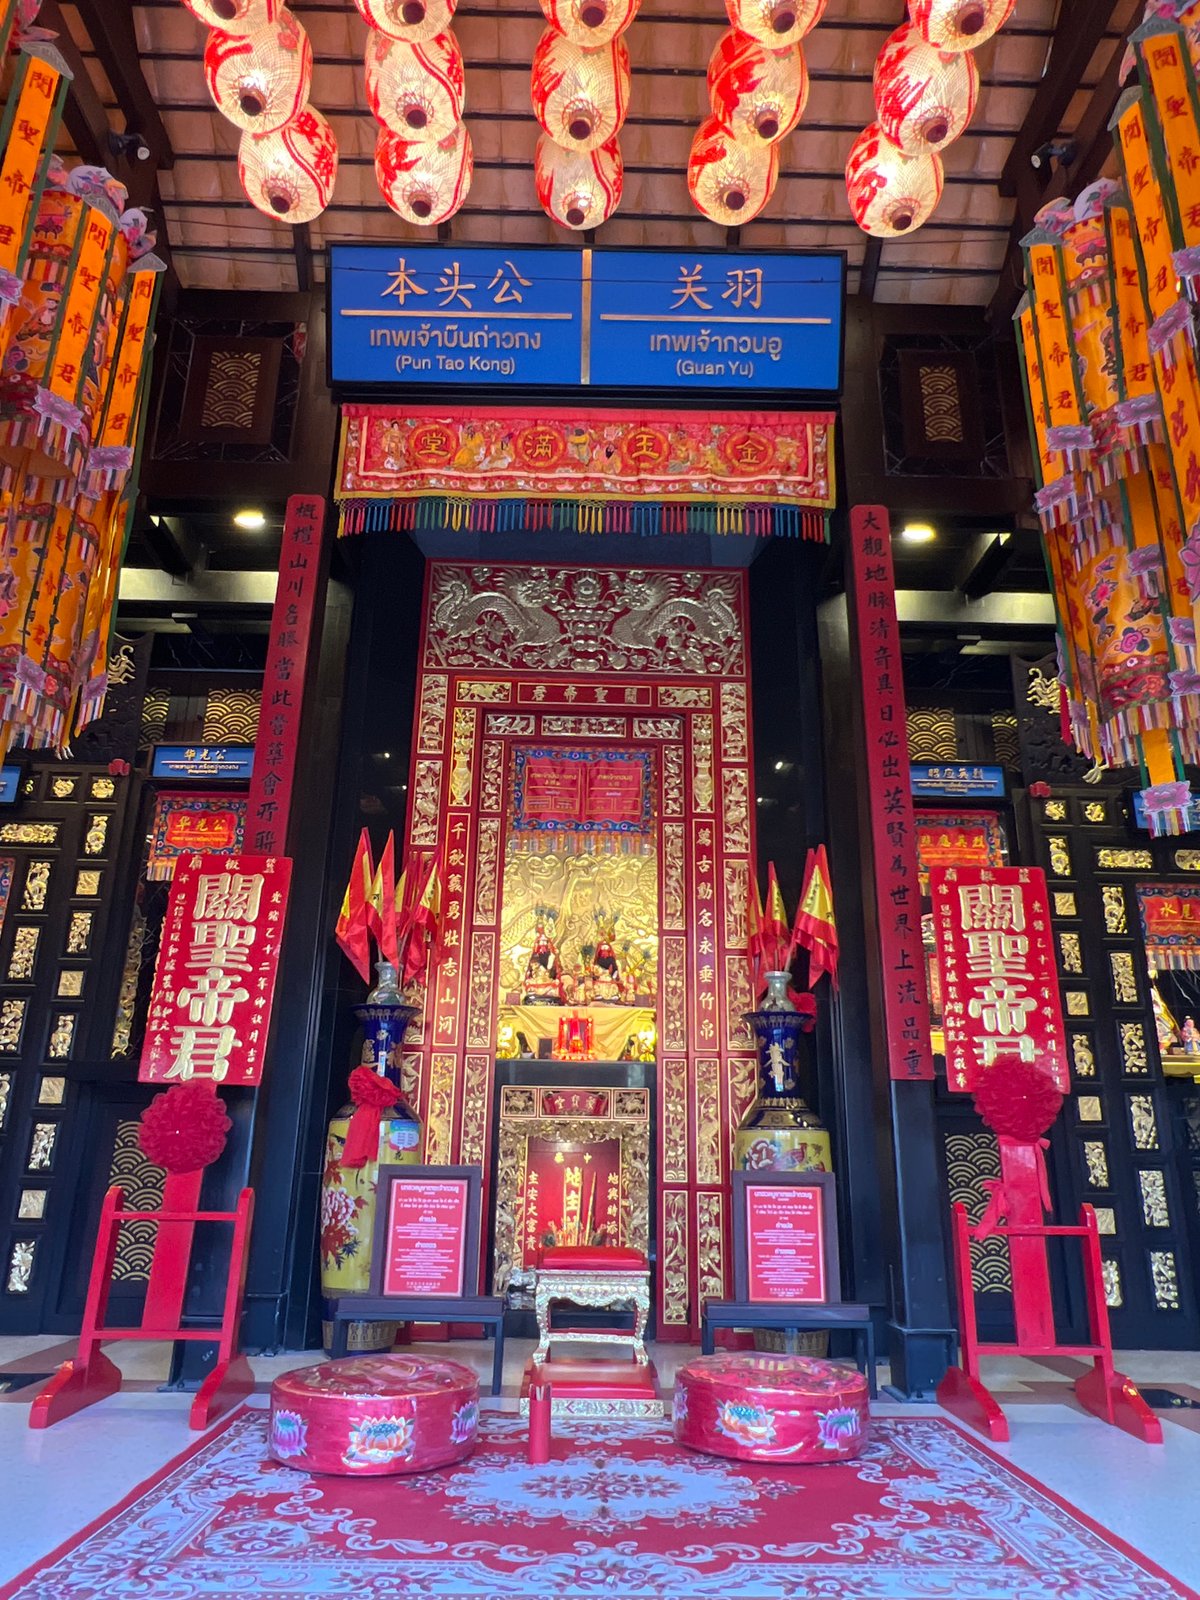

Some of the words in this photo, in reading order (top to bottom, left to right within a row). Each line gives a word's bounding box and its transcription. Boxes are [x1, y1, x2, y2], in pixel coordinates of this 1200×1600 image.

[380, 258, 533, 309] 本头公
[670, 264, 763, 311] 关羽
[395, 355, 431, 373] (Pun
[436, 355, 464, 371] Tao
[469, 356, 515, 374] Kong)
[650, 329, 783, 361] เทพเจ้ากวนอู
[676, 359, 725, 377] (Guan
[728, 361, 754, 378] Yu)
[163, 872, 265, 1082] 關聖帝君
